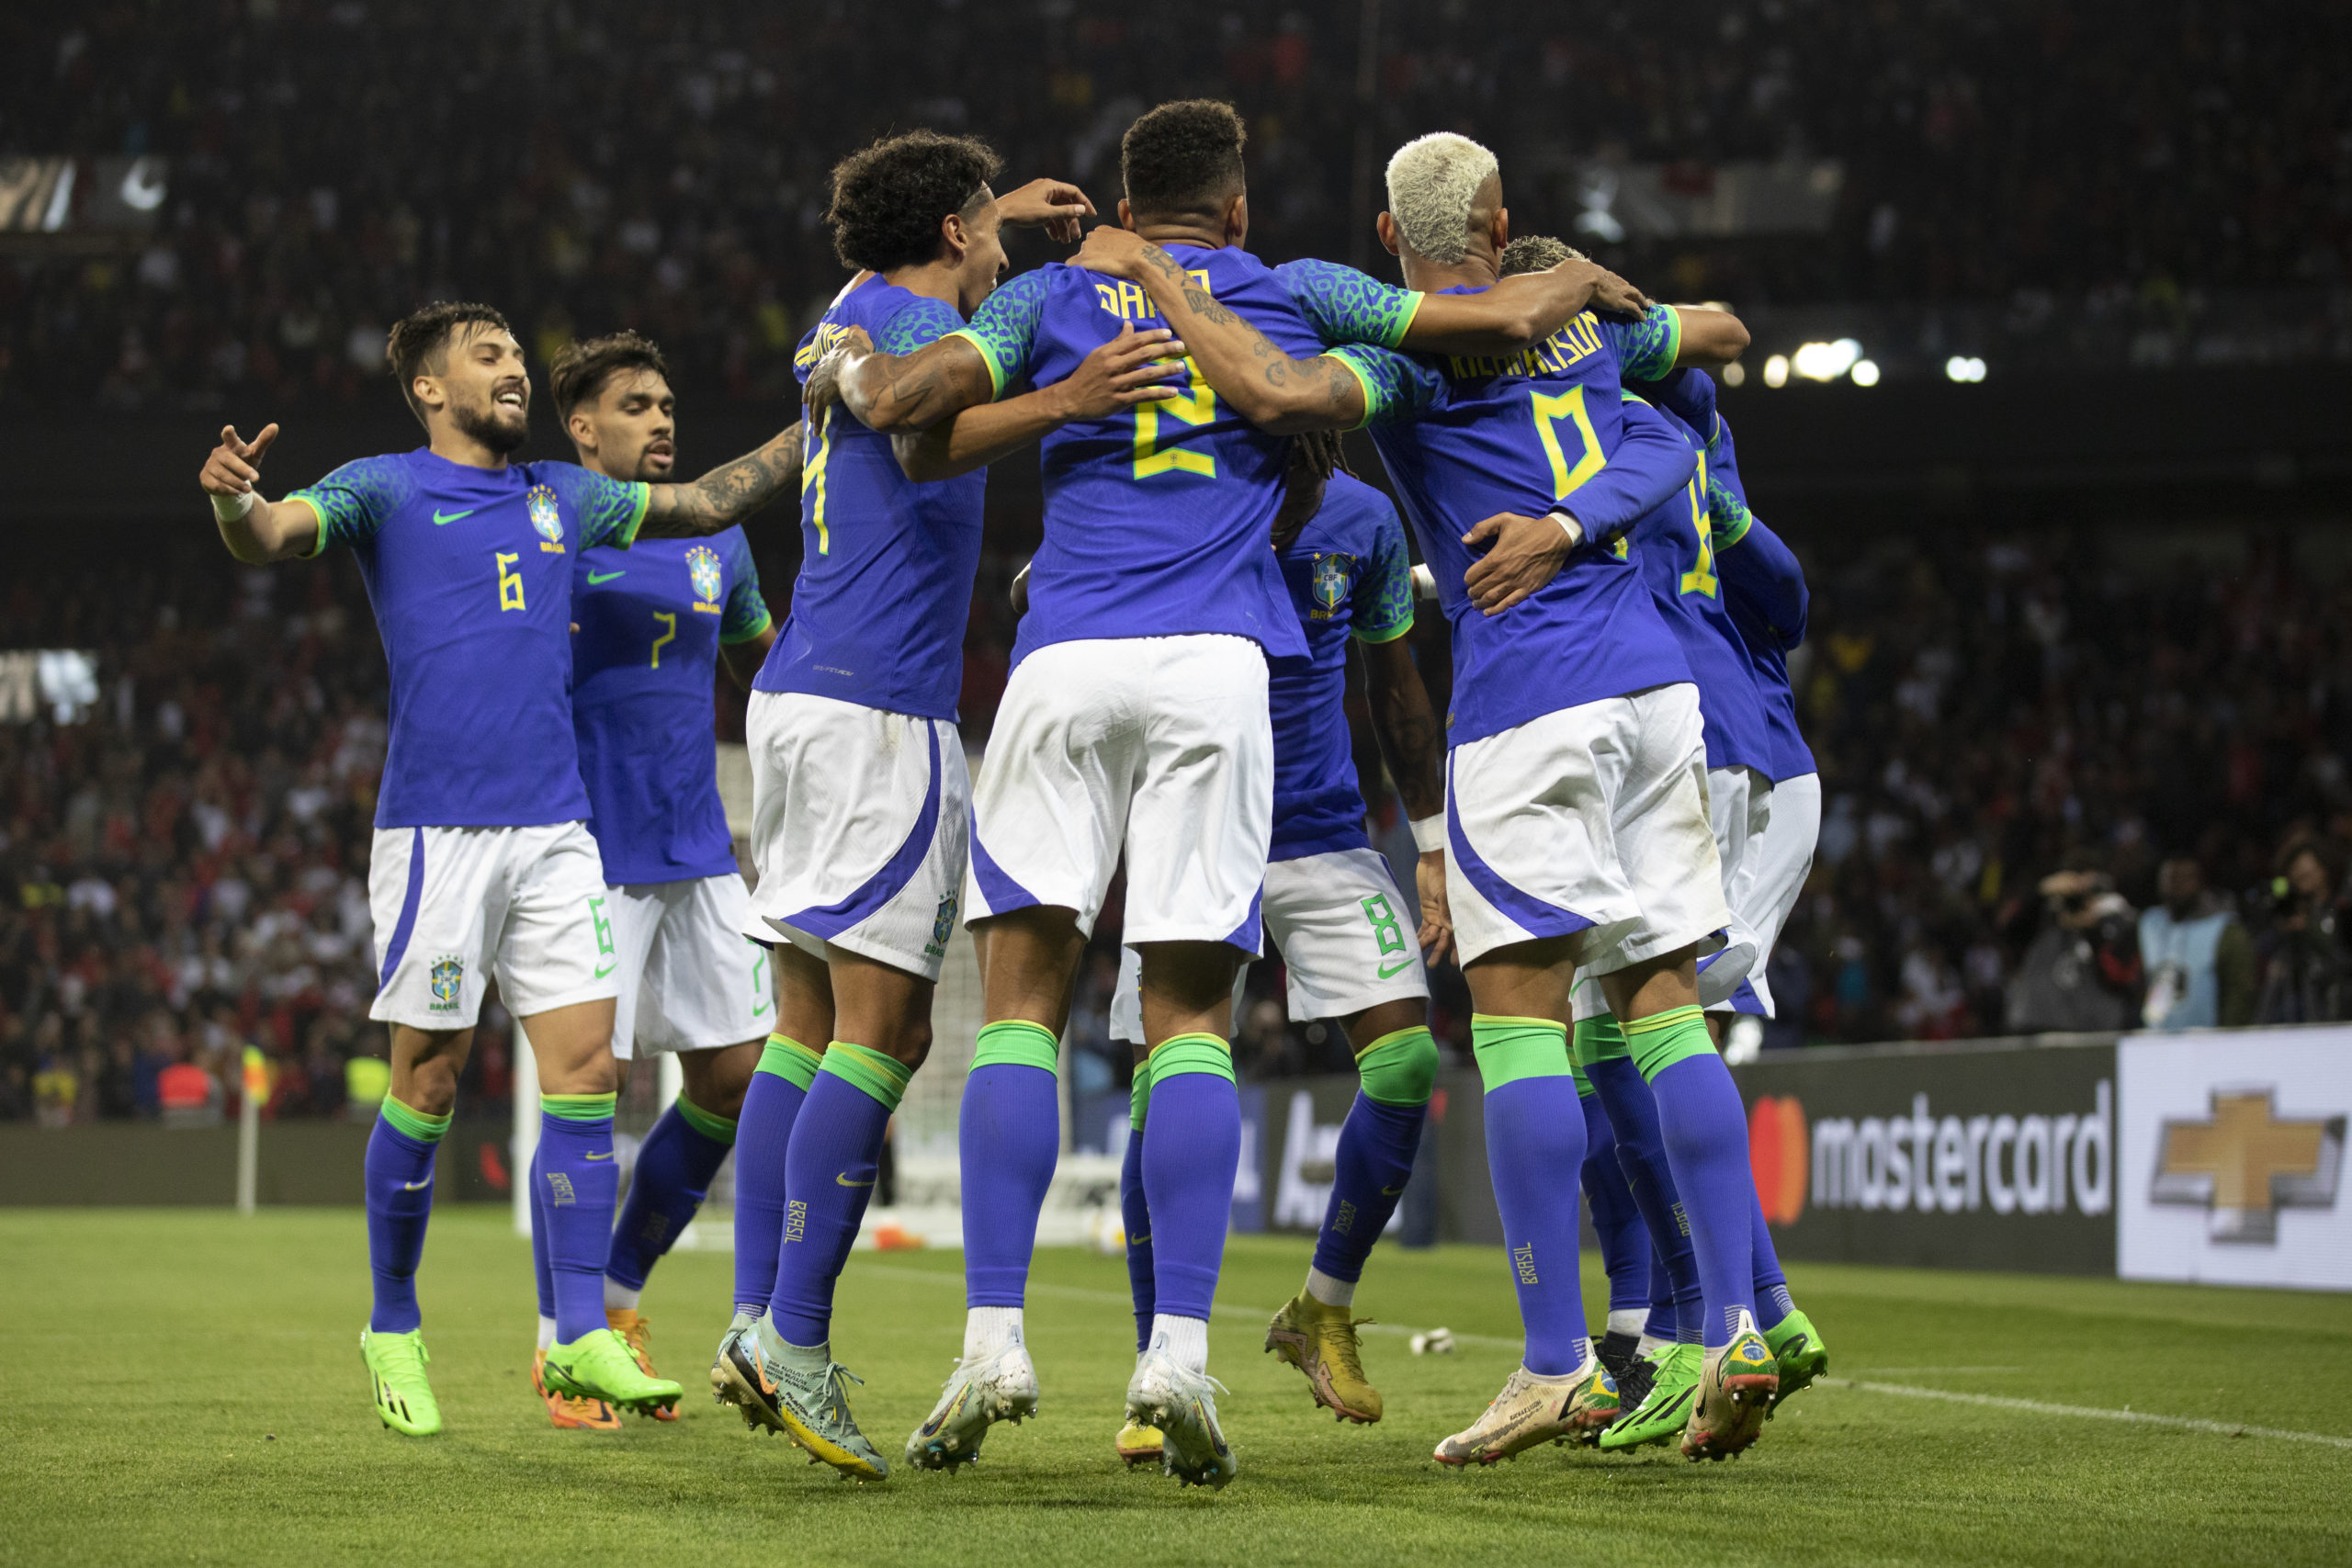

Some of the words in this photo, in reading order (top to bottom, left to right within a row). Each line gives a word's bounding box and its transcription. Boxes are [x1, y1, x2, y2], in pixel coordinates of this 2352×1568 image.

[1133, 343, 1216, 480] 2
[539, 542, 566, 554] BRASIL
[495, 552, 526, 612] 6
[1323, 573, 1339, 581] CBF
[693, 601, 721, 615] BRASIL
[650, 610, 676, 669] 7
[588, 897, 615, 955] 6
[1360, 893, 1407, 956] 8
[429, 1002, 459, 1011] BRASIL
[1812, 1077, 2112, 1215] mastercard
[546, 1172, 577, 1209] BRASIL
[785, 1200, 808, 1245] BRASIL
[1513, 1241, 1539, 1284] BRASIL
